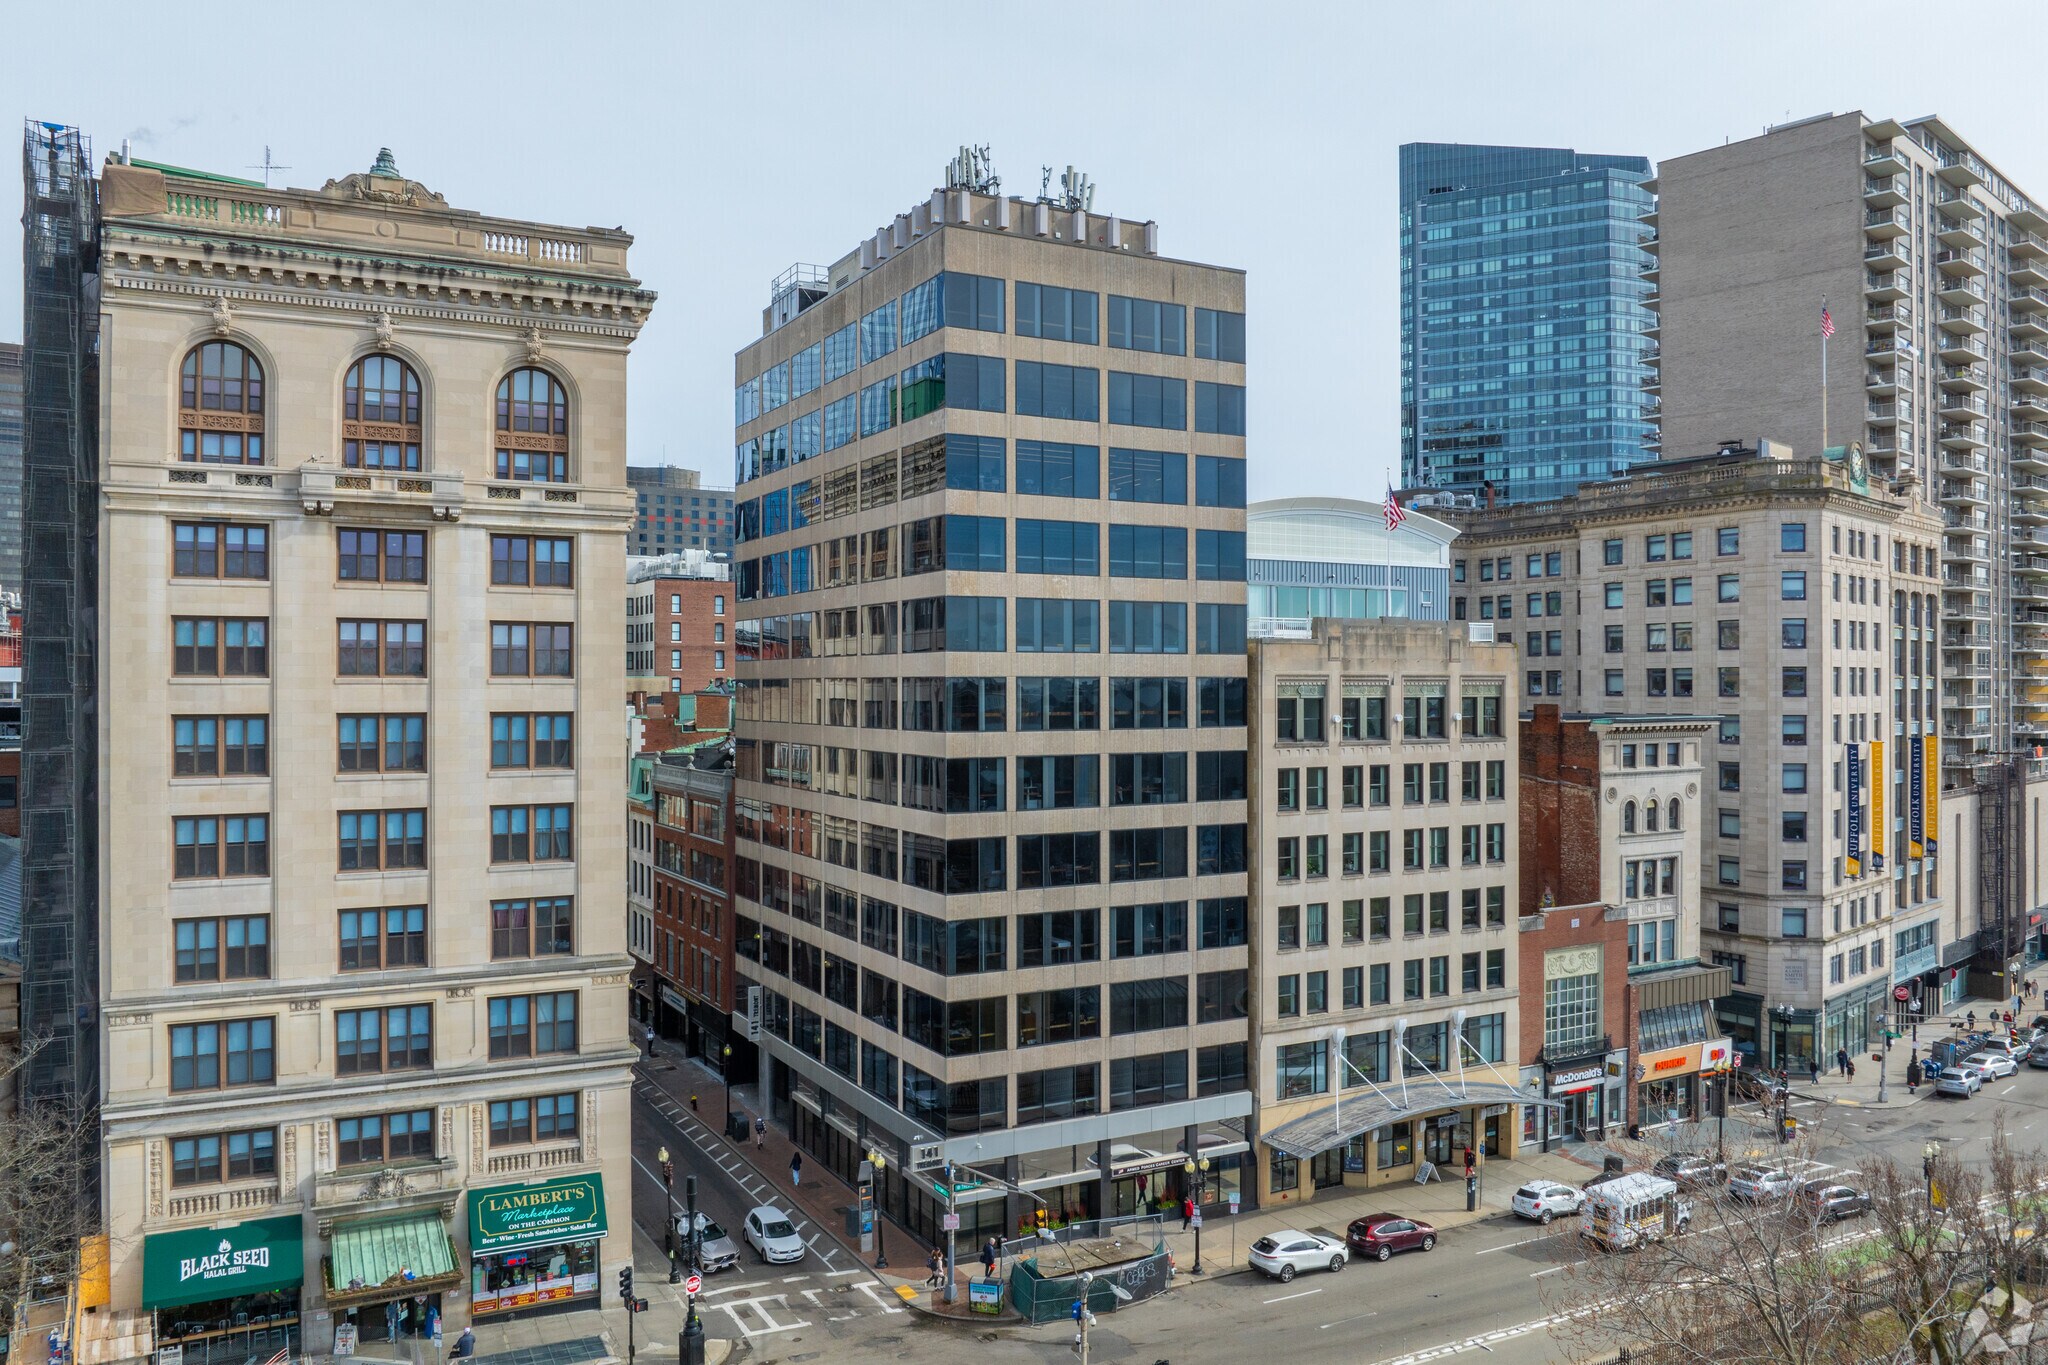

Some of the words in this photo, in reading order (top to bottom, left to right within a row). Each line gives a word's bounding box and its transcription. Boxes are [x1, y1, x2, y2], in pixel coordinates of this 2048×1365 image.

[1850, 748, 1858, 808] UNIVERSITY
[1912, 742, 1920, 796] UNIVERSITY
[1912, 797, 1920, 841] SUFFOLK
[1849, 810, 1858, 857] SUFFOLK
[751, 1020, 759, 1035] 141
[1555, 1067, 1602, 1085] McDonald's
[920, 1146, 939, 1160] 141
[489, 1187, 585, 1211] LAMBERT'S
[500, 1204, 575, 1222] Marketplace
[536, 1216, 570, 1226] COMMON
[534, 1227, 568, 1237] Sandwiches
[180, 1252, 230, 1282] BLACK
[233, 1247, 269, 1268] SEED
[203, 1269, 227, 1279] HALAL
[228, 1265, 247, 1276] GRILL
